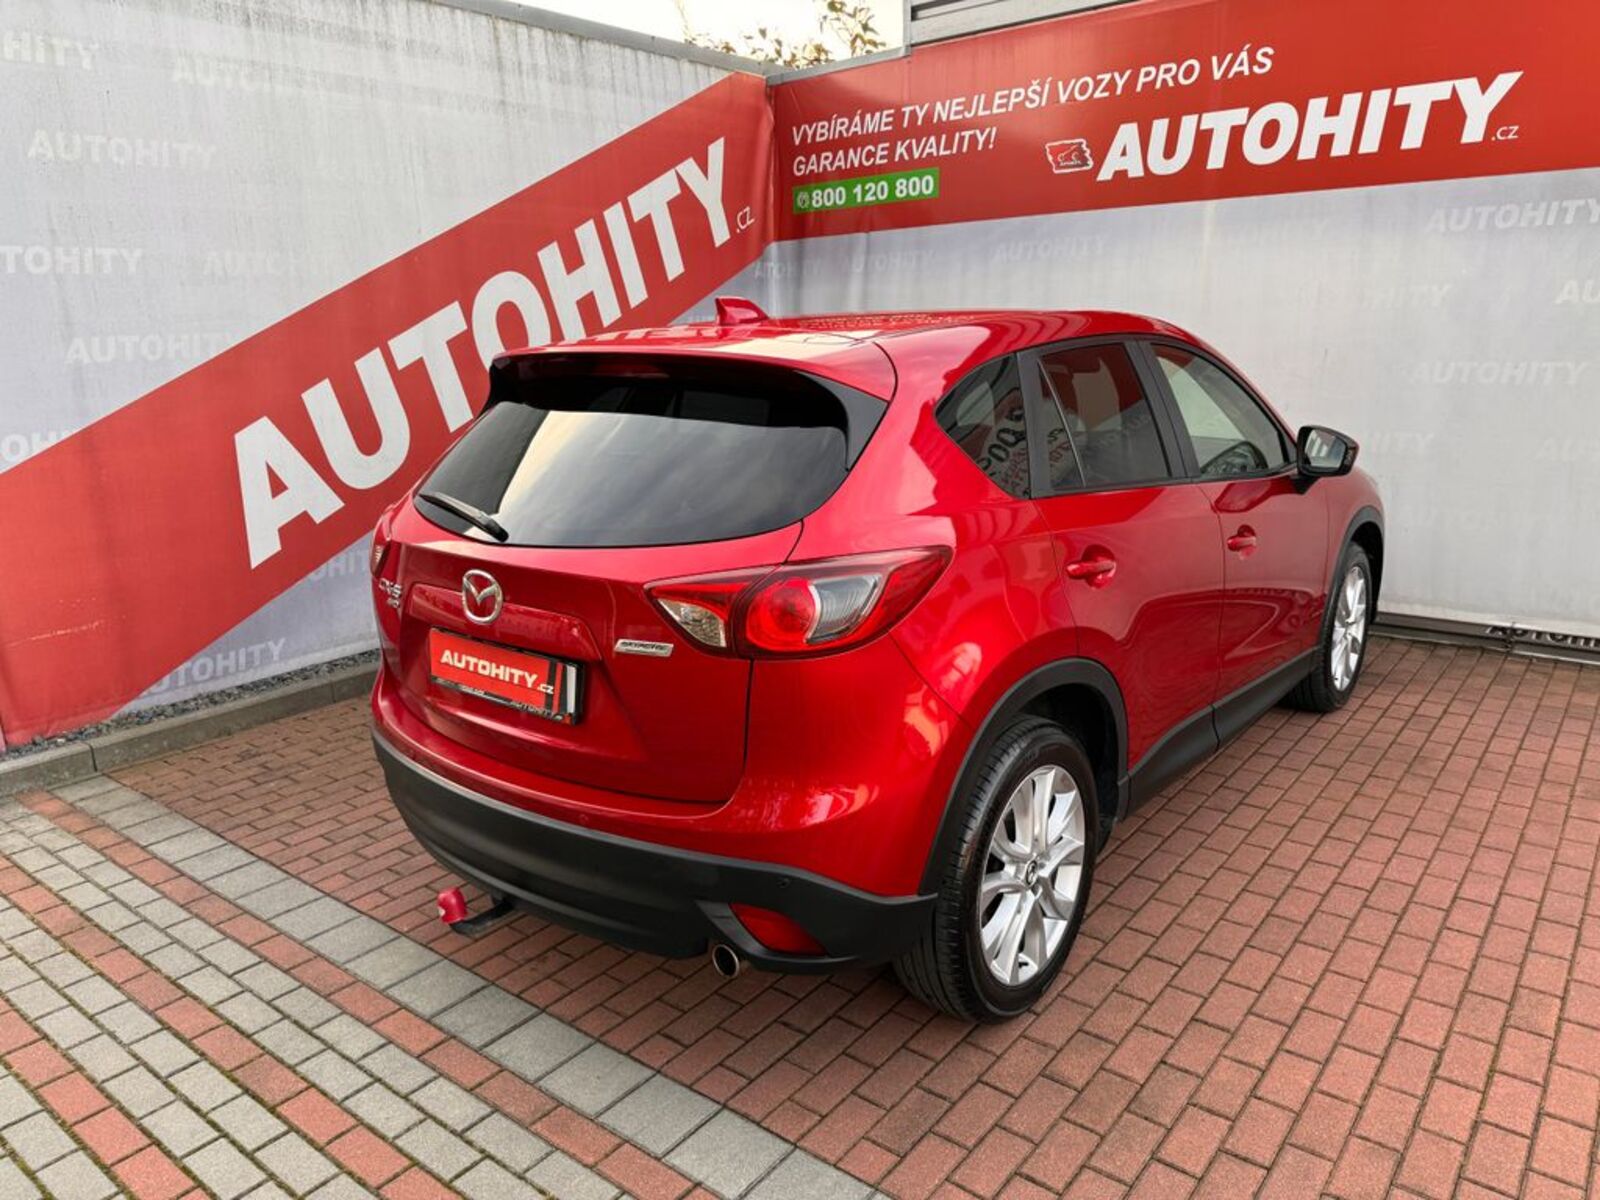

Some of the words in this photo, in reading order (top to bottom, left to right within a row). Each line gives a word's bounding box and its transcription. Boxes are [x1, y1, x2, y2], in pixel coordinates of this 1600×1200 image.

[792, 109, 894, 146] VYBÍRÁME
[901, 103, 930, 128] TY
[933, 77, 1052, 123] NEJLEPŠÍ
[1057, 69, 1131, 104] VOZY
[1136, 58, 1200, 92] PRO
[1211, 43, 1274, 81] VÁS
[28, 129, 216, 169] AUTOHITY
[793, 142, 889, 176] GARANCE
[895, 126, 997, 162] KVALITY!
[812, 186, 846, 208] 800
[853, 181, 888, 203] 120
[895, 175, 934, 197] 800
